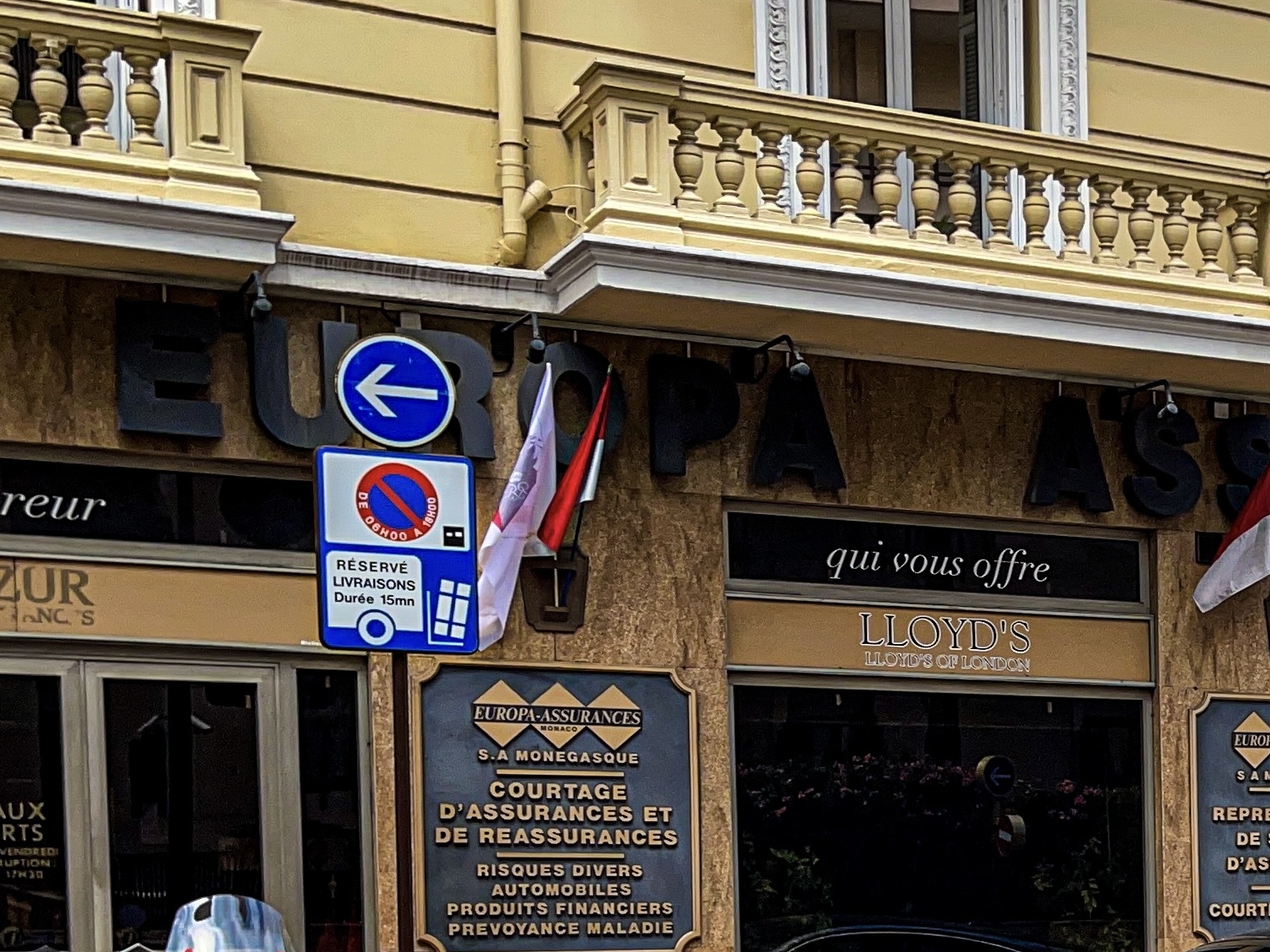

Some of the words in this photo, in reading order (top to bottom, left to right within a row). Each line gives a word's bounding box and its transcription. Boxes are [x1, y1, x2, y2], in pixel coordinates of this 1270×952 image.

[116, 298, 847, 491] EUROPA
[358, 491, 369, 509] DE
[365, 516, 407, 541] 06H00
[414, 528, 423, 538] A
[423, 497, 437, 528] 18H00
[337, 557, 408, 574] RÉSERVÉ
[826, 540, 881, 581] qui
[893, 552, 962, 577] vous
[973, 547, 1051, 589] offre
[333, 576, 416, 591] LIVRAISONS
[334, 592, 374, 604] Durée
[381, 594, 415, 606] 15mn
[858, 612, 1032, 654] LLOYD'S
[865, 652, 933, 669] LLOYD'S
[936, 653, 958, 669] OF
[961, 655, 1031, 673] LONDON
[473, 706, 642, 726] EUROPA-ASSURANCES
[540, 725, 578, 733] MONACO
[478, 748, 508, 762] S.A
[516, 750, 639, 765] MONEGASQUE
[489, 780, 627, 801] COURTAGE
[439, 803, 633, 823] D'ASSURANCES
[643, 806, 673, 823] ET
[435, 827, 468, 844] DE
[479, 827, 678, 846] REASSURANCES
[1236, 832, 1261, 847] DE
[477, 863, 565, 878] RISQUES
[572, 864, 644, 878] DIVERS
[491, 883, 632, 897] AUTOMOBILES
[447, 902, 549, 916] PRODUITS
[556, 902, 674, 916] FINANCIERS
[448, 922, 580, 936] PREVOYANCE
[587, 921, 674, 935] MALADIE
